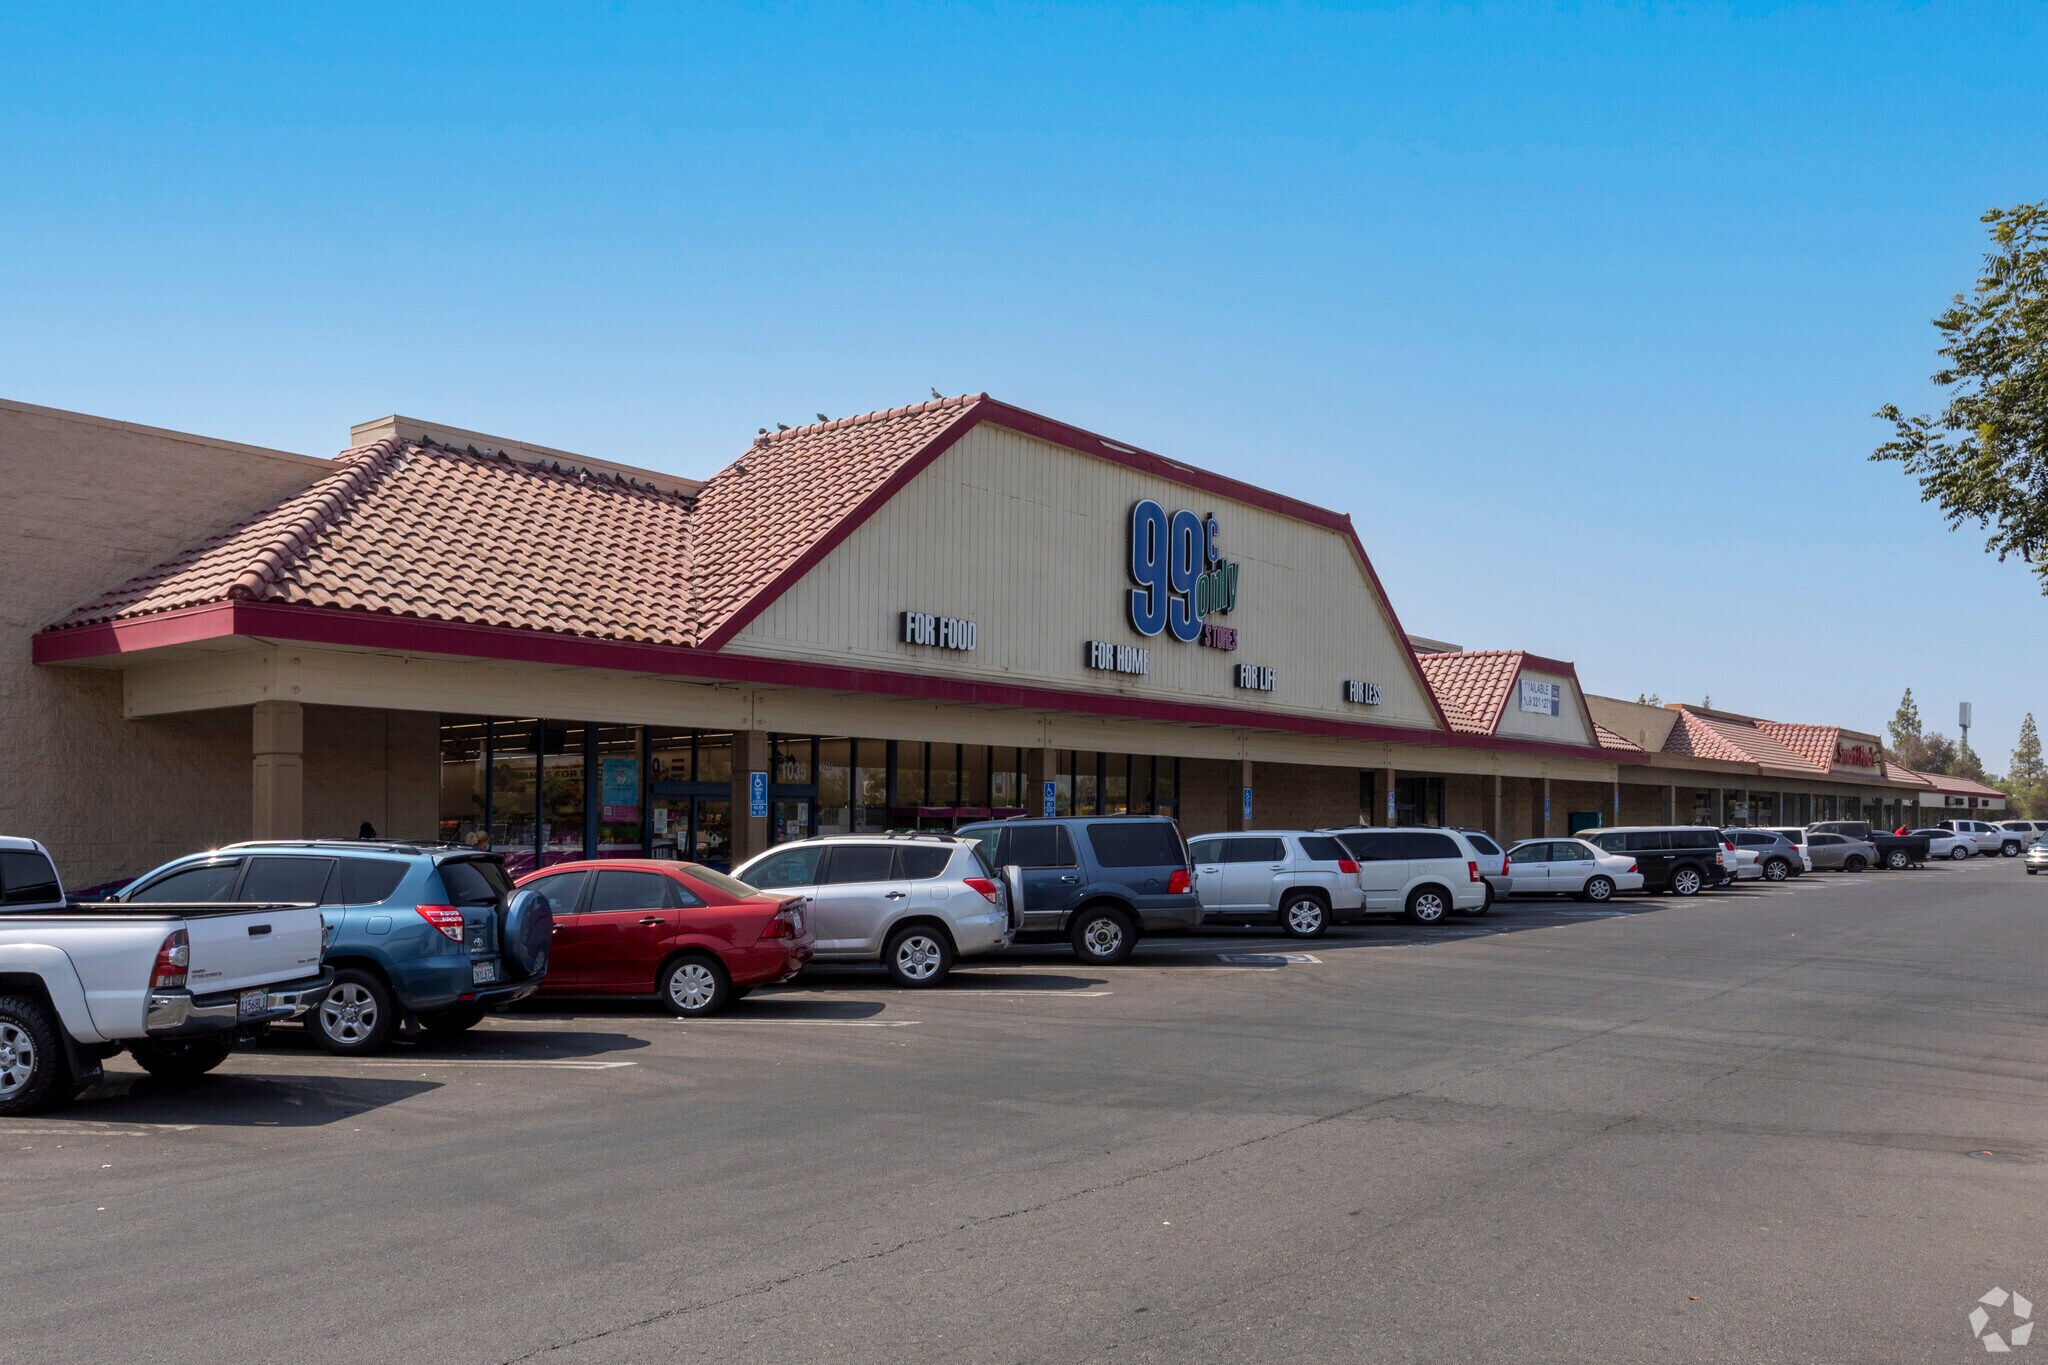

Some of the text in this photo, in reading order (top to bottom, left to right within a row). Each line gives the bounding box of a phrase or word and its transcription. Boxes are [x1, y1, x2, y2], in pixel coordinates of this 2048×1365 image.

[1196, 557, 1240, 618] only
[906, 611, 977, 651] FOR FOOD
[1204, 624, 1239, 651] STORES
[1091, 640, 1150, 675] FOR HOME
[1240, 664, 1277, 691] FOR LIFE
[1350, 680, 1382, 705] FOR LESS
[781, 760, 807, 781] 1035
